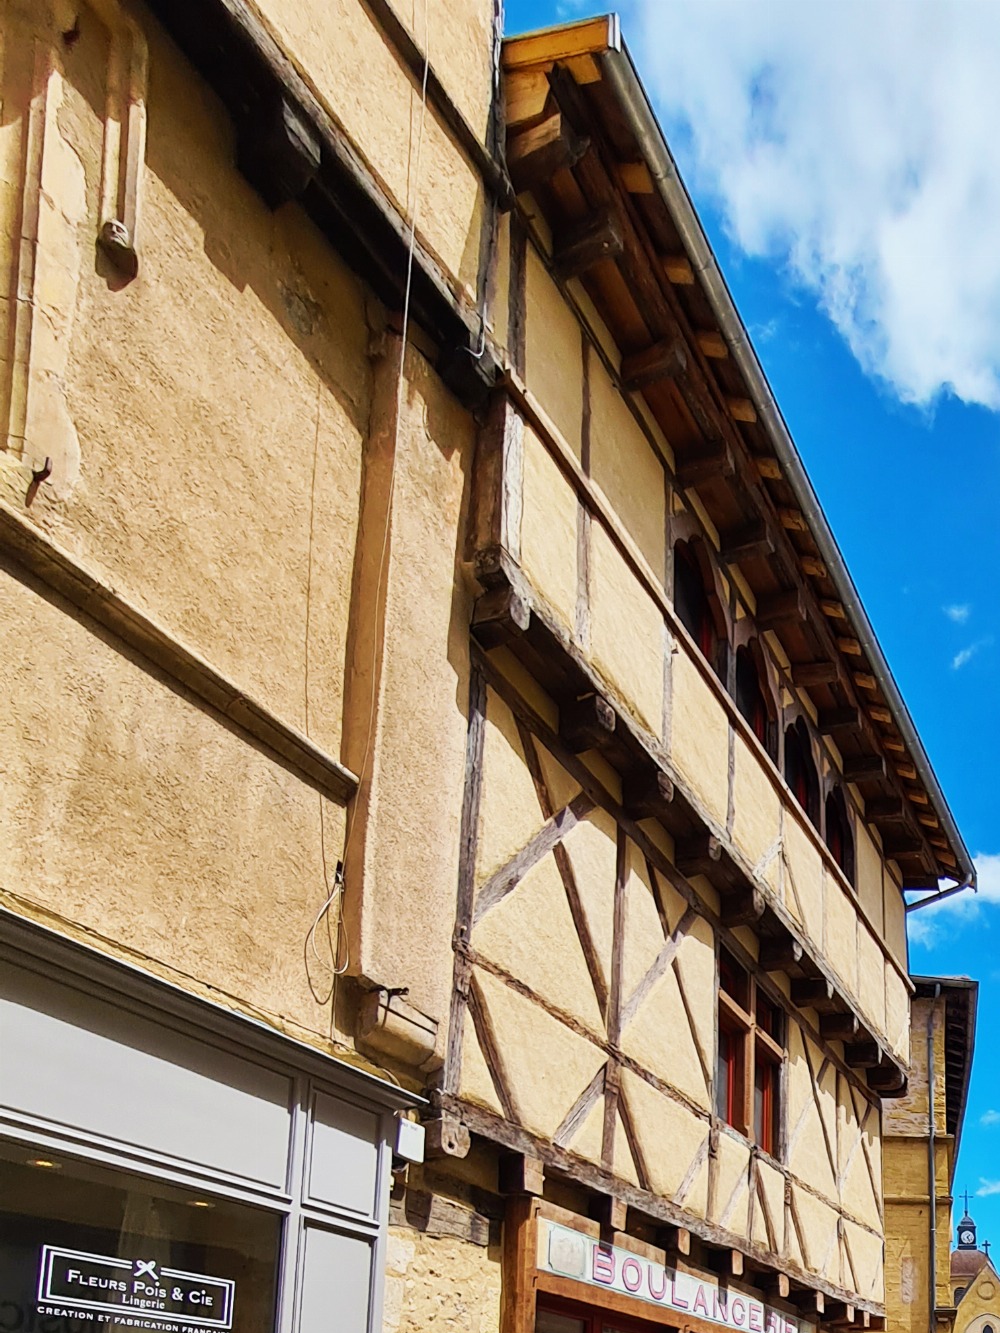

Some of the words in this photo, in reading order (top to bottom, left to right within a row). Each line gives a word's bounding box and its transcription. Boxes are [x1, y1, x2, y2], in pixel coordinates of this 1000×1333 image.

[67, 1269, 127, 1291] FLEURS
[172, 1287, 184, 1301] &
[122, 1293, 165, 1309] Lingerie
[37, 1306, 94, 1320] CREATION
[98, 1314, 110, 1322] ET
[114, 1317, 179, 1332] FABRICATION
